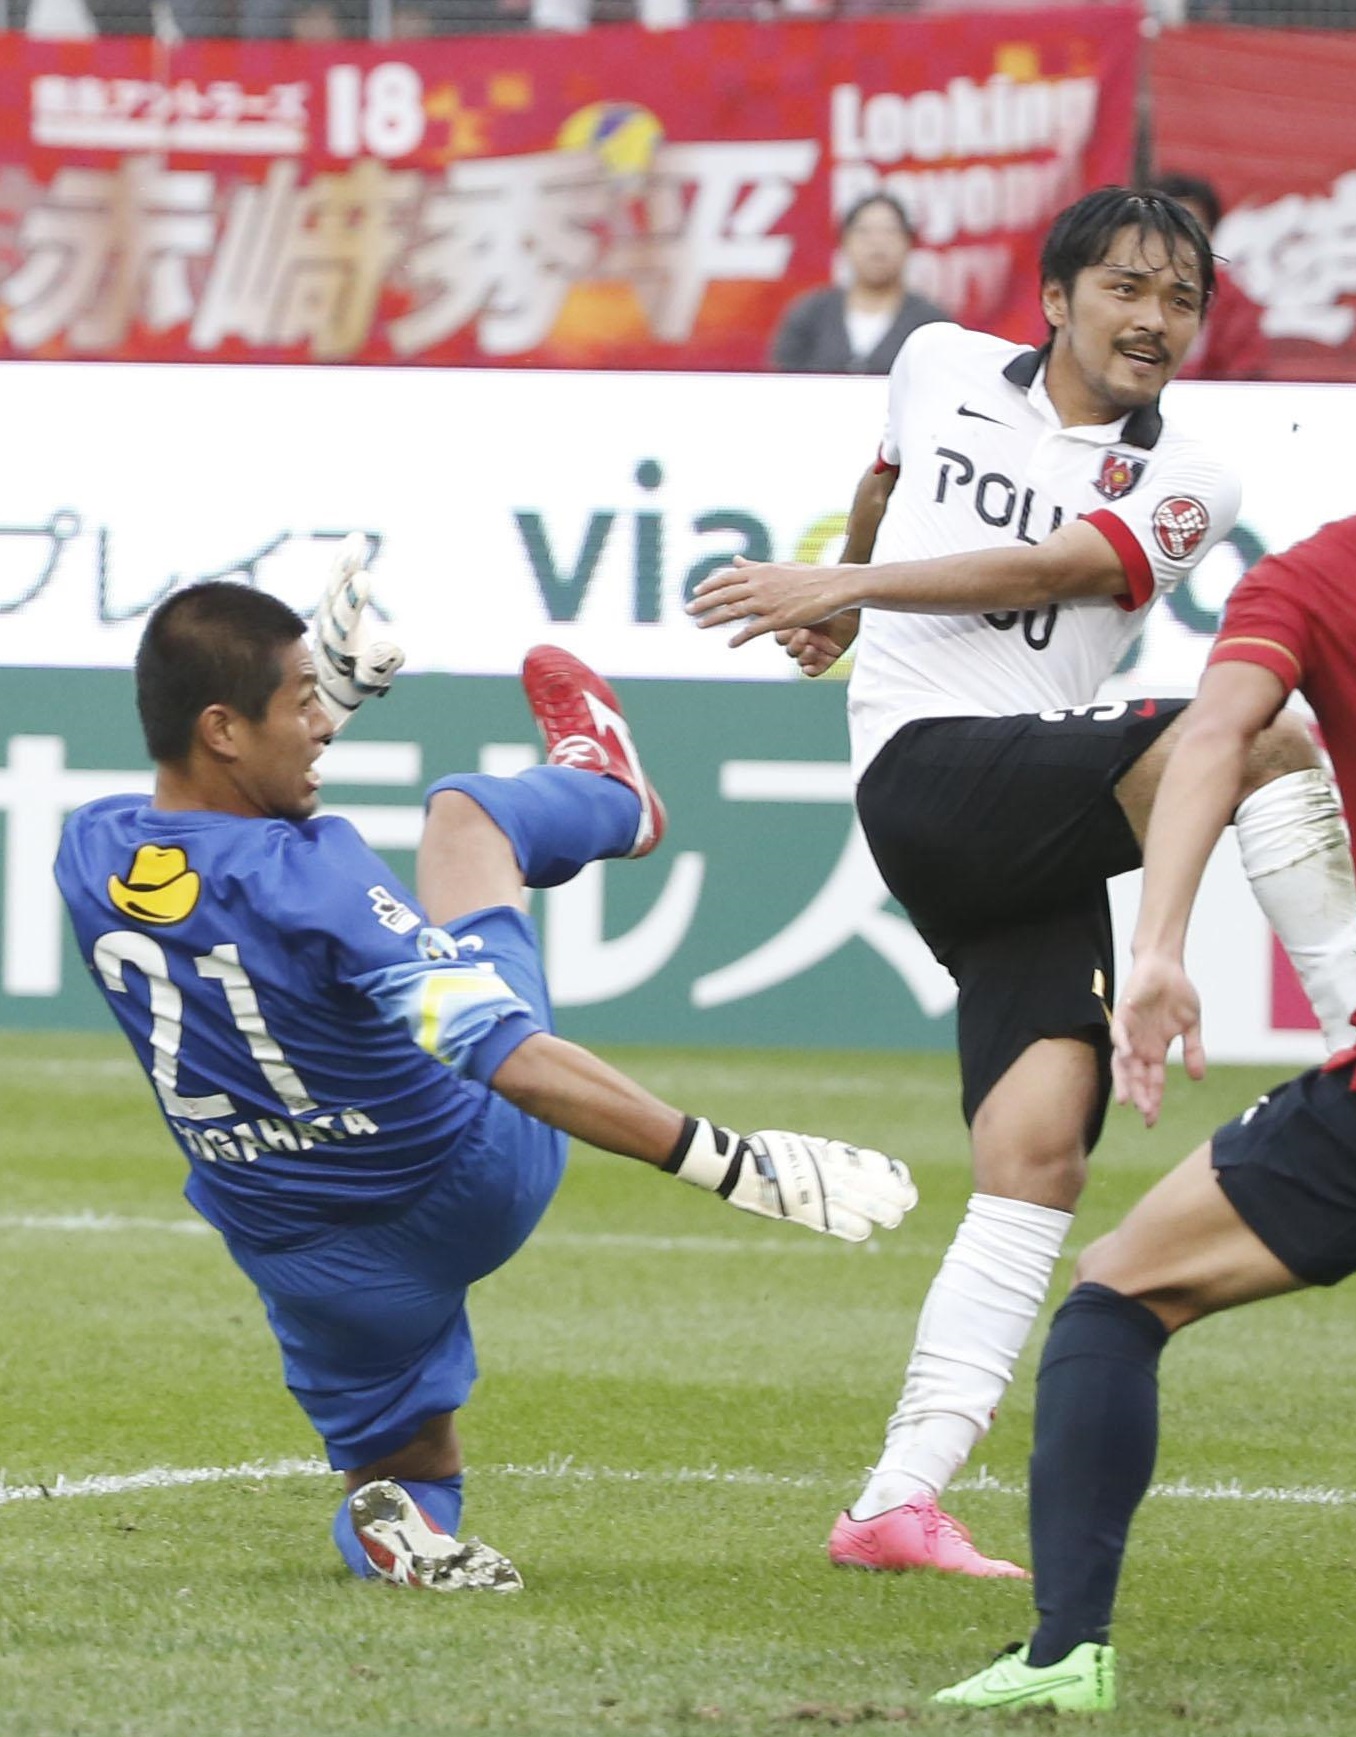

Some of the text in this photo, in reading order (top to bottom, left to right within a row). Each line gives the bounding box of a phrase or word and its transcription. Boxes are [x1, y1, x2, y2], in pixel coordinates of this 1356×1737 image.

[326, 62, 425, 158] 18
[93, 930, 320, 1121] 21
[171, 1107, 380, 1163] OGAHATA
